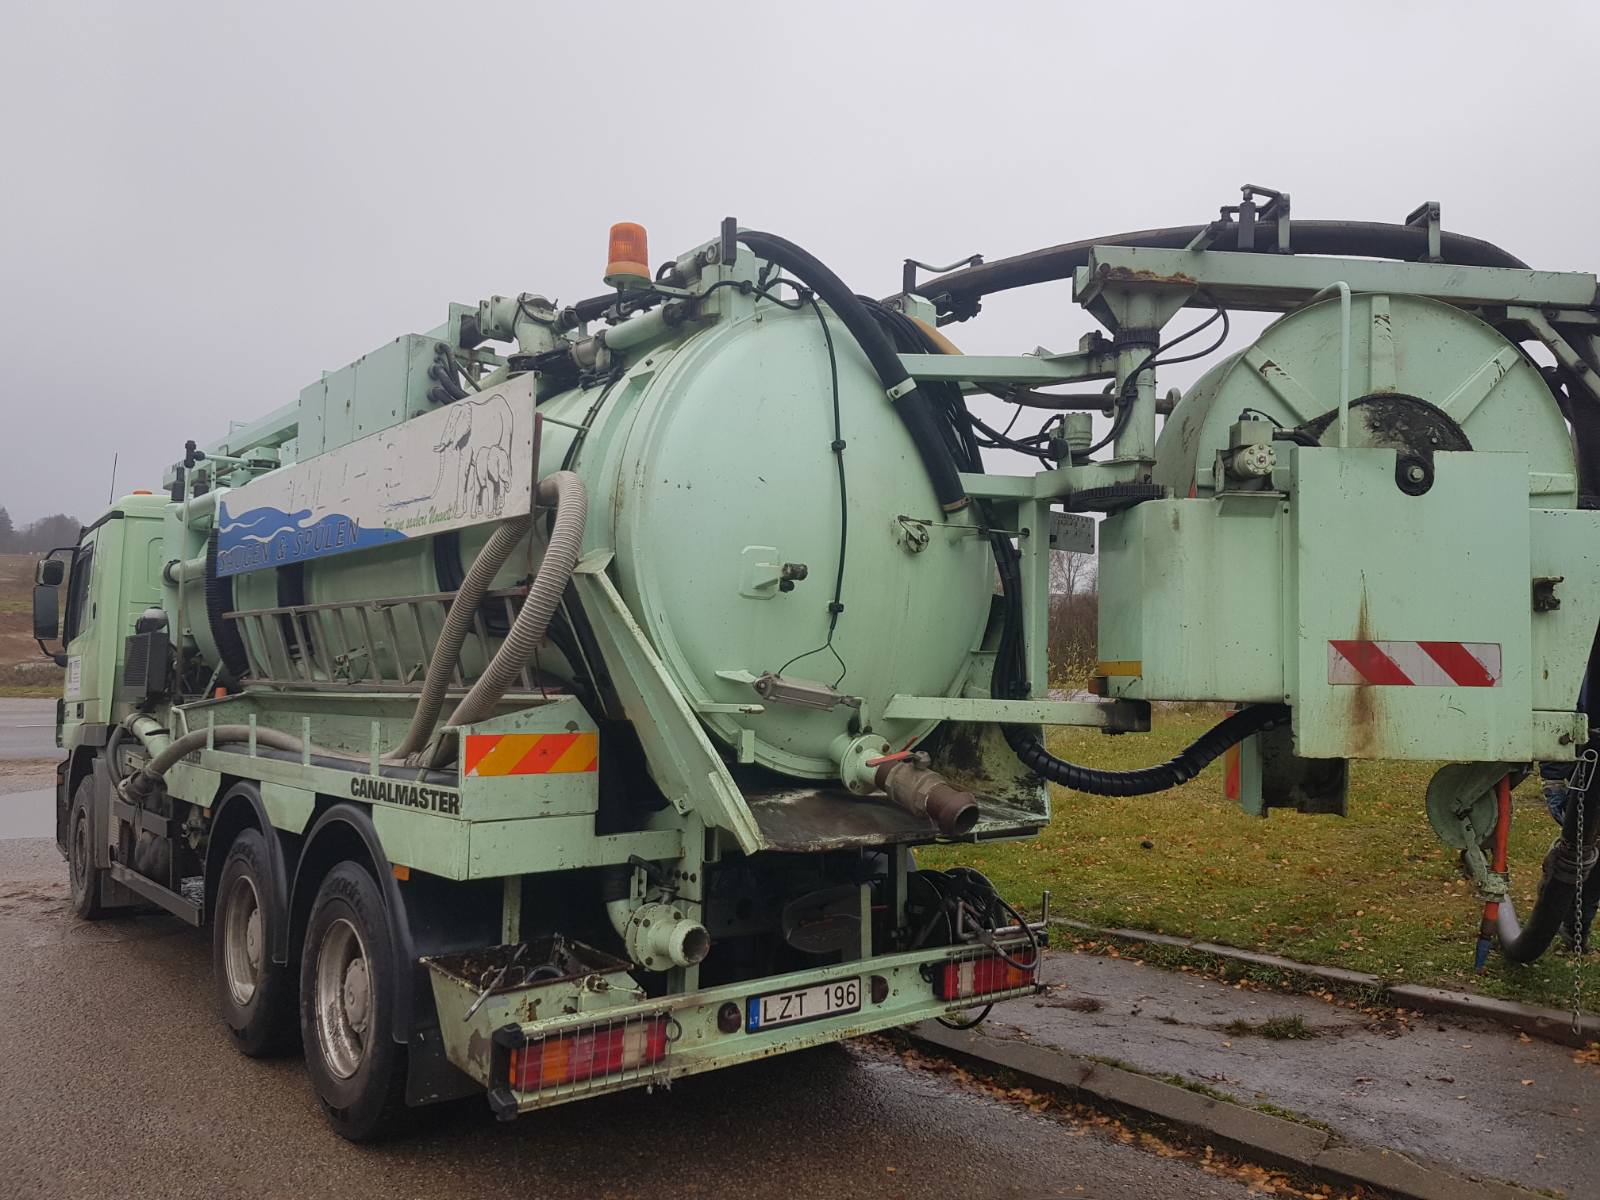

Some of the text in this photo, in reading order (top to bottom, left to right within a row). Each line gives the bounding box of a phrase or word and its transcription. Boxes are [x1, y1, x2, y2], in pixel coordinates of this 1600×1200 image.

[277, 536, 287, 560] &
[351, 777, 460, 815] CANALMASTER
[763, 983, 857, 1023] LZT 196
[749, 1016, 759, 1025] LT
